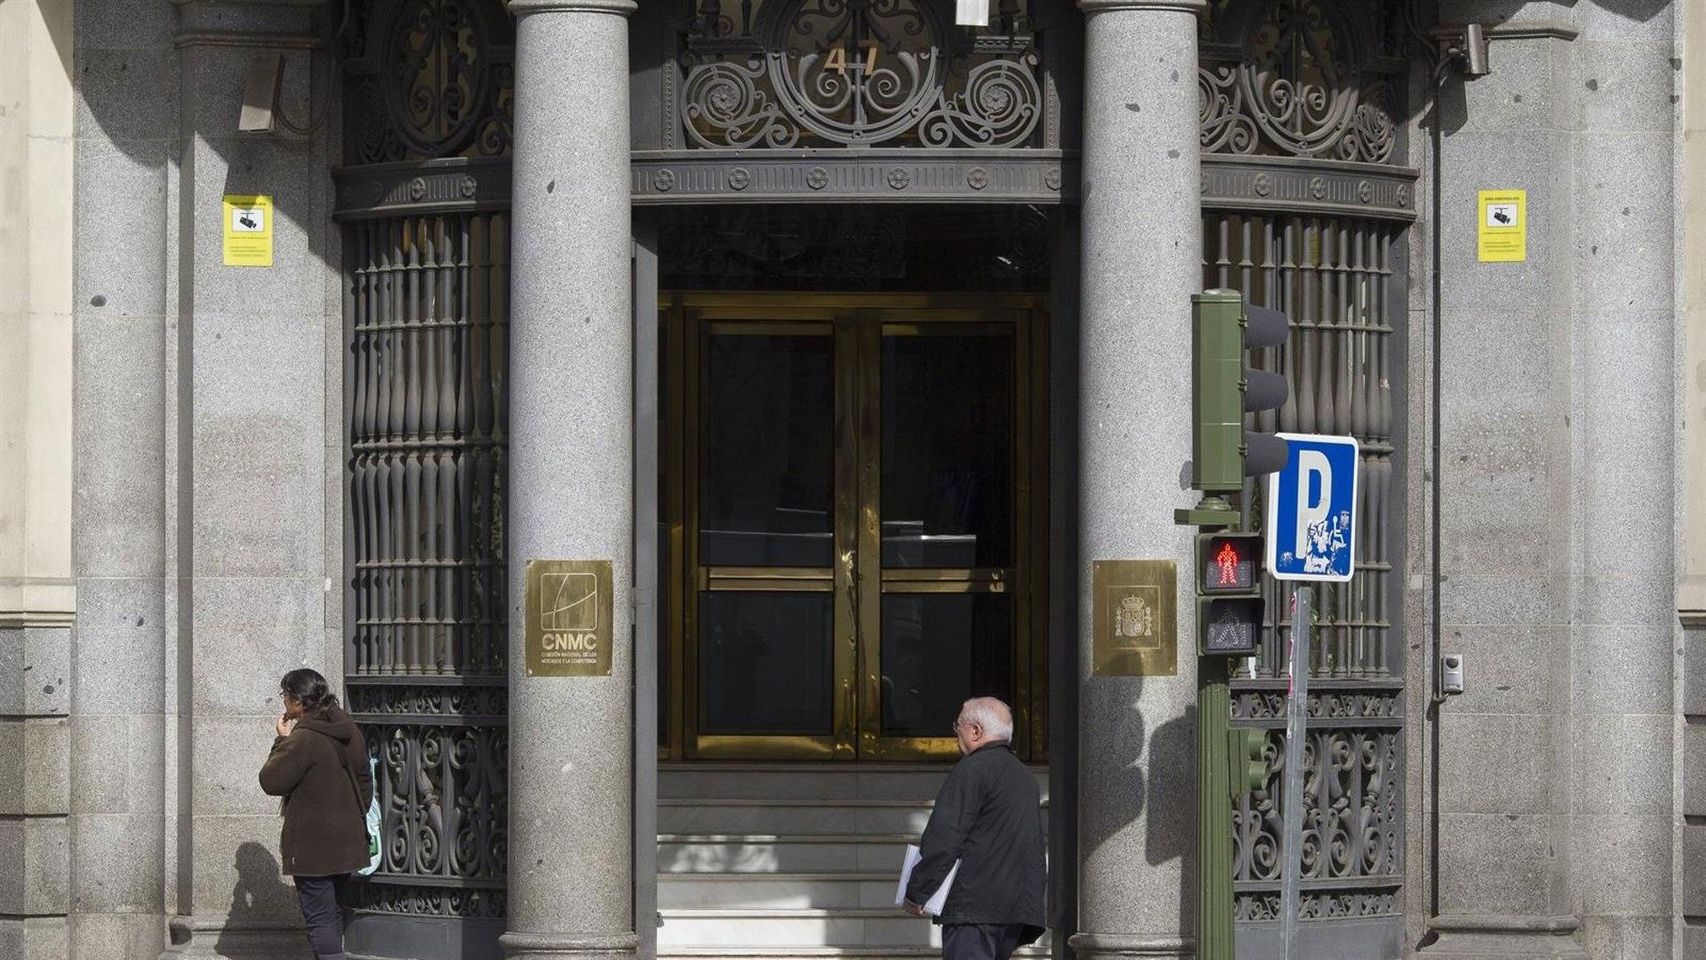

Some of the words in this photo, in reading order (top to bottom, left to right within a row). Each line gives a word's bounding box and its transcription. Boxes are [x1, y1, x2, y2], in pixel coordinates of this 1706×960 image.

[824, 39, 879, 76] 47
[1295, 449, 1332, 559] P
[542, 633, 597, 650] CNMC
